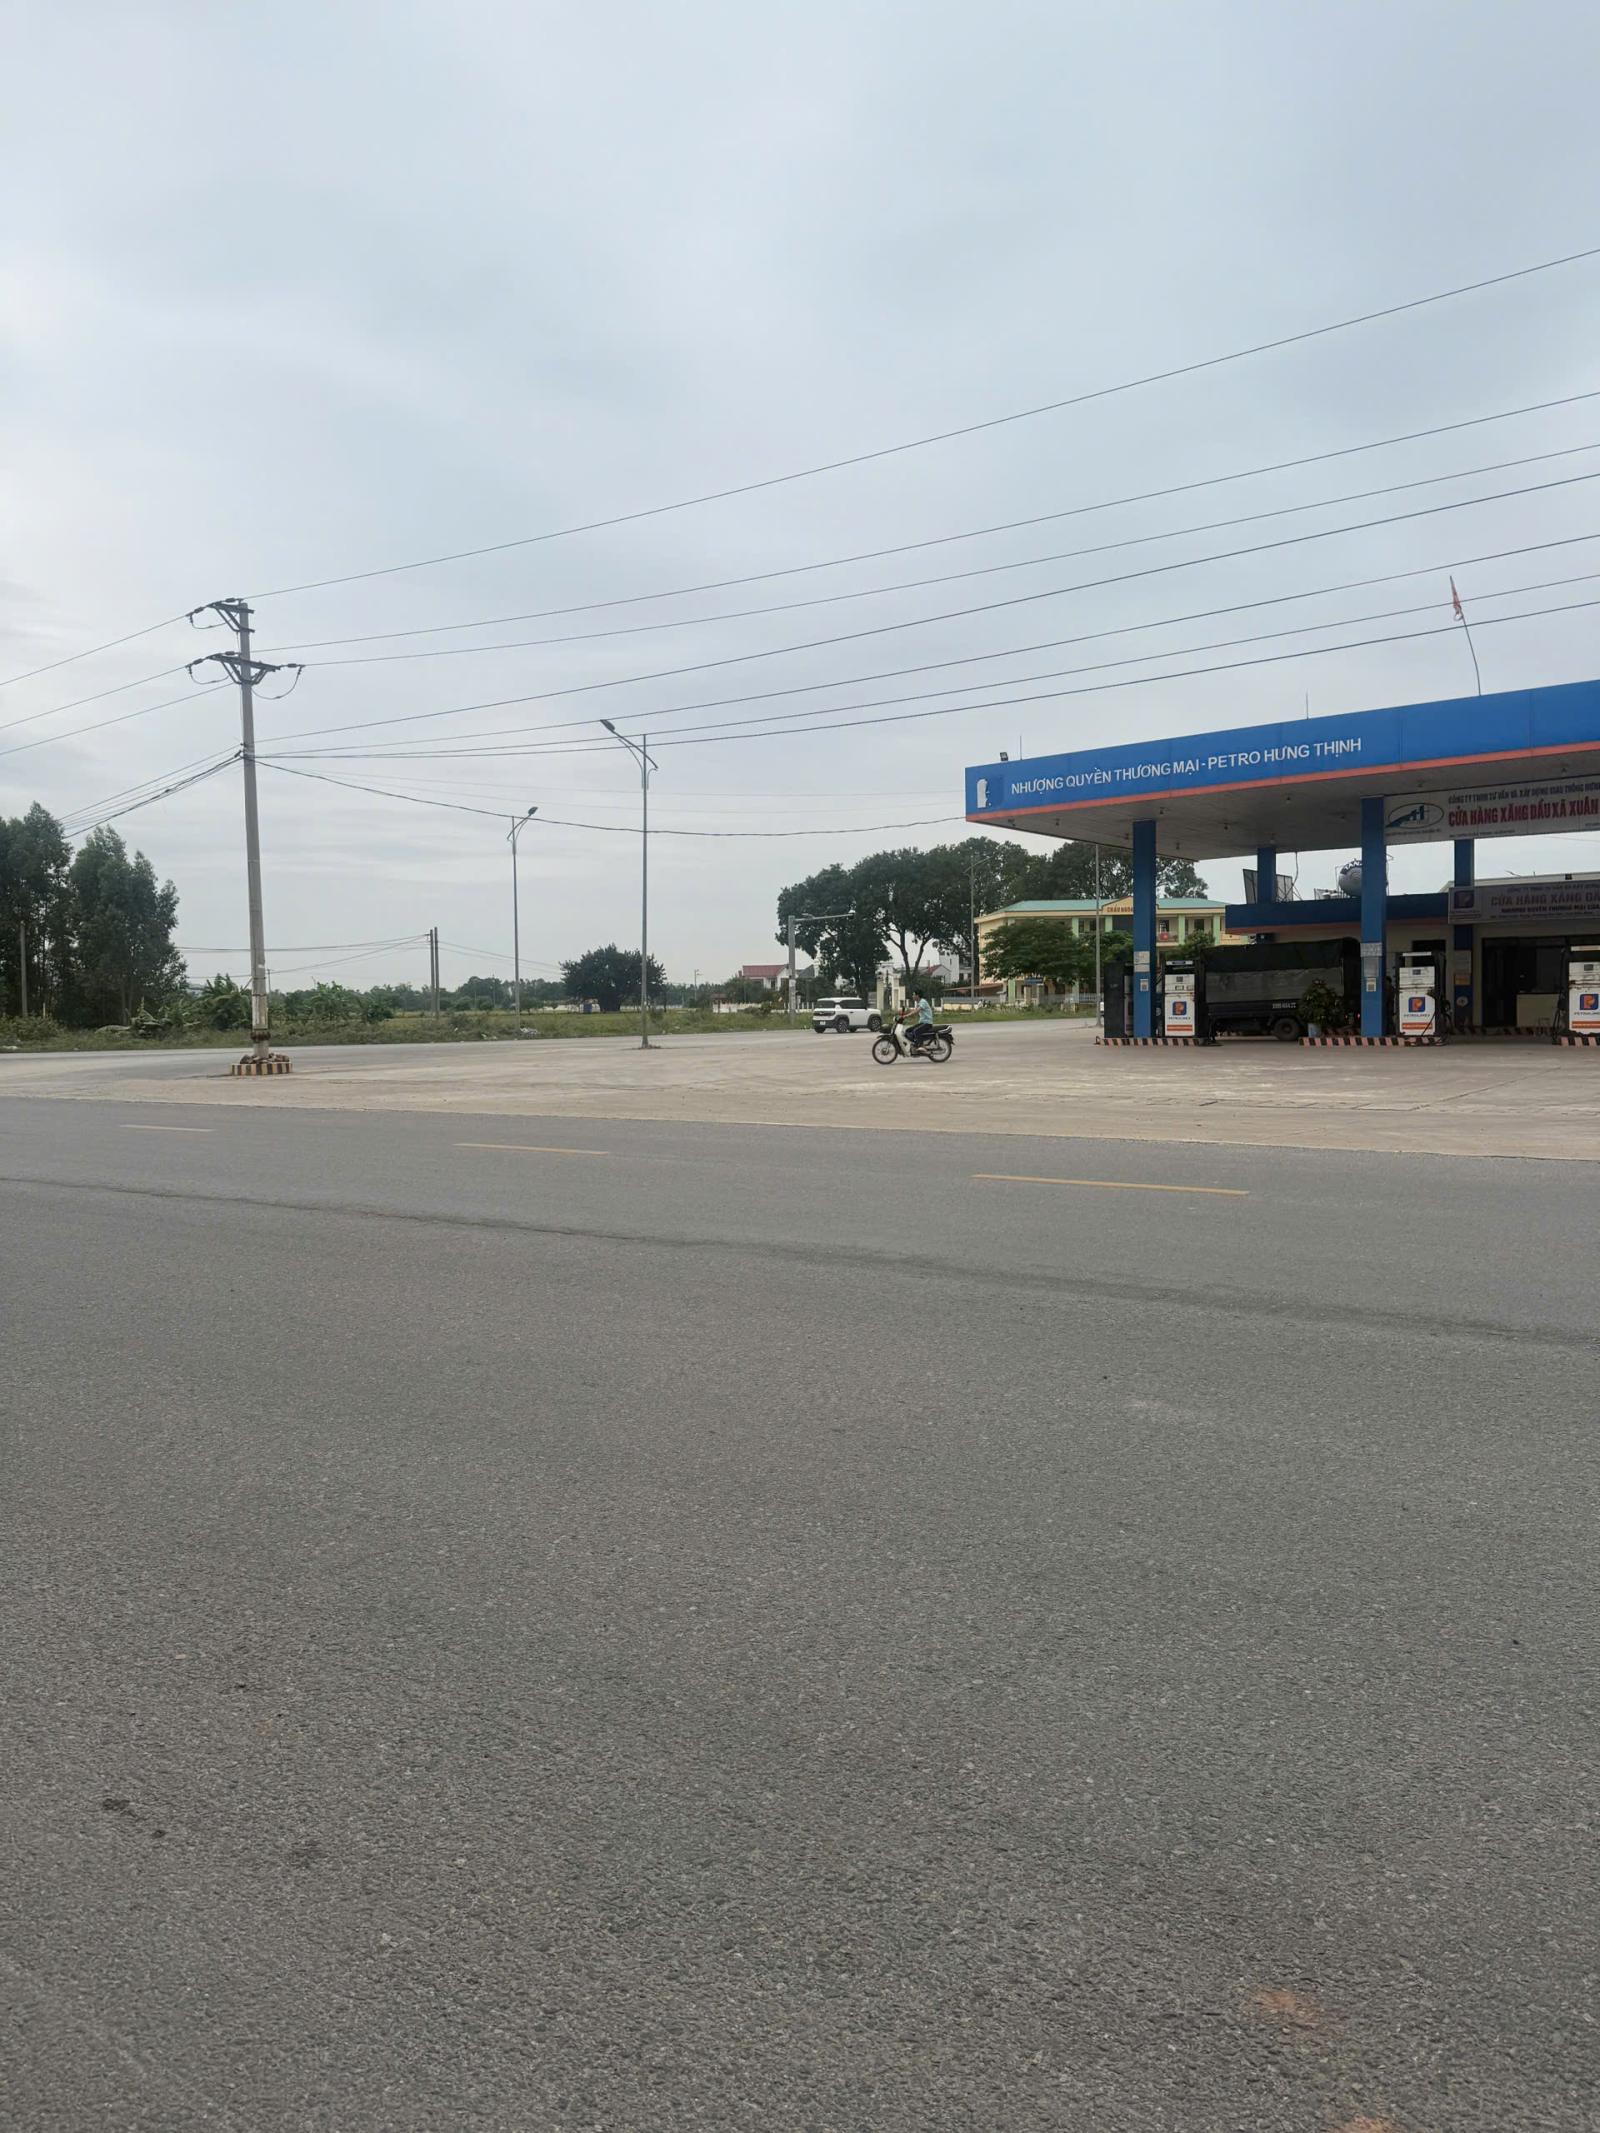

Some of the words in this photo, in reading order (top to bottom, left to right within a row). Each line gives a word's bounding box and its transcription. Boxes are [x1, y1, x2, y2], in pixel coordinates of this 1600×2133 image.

[1011, 777, 1064, 794] NHƯỢNG
[1066, 767, 1111, 787] QUYỀN
[1114, 763, 1170, 782] THƯƠNG
[1264, 745, 1310, 762] HƯNG
[1313, 737, 1361, 757] THỊNH
[1448, 806, 1469, 827] CỬA
[1470, 806, 1498, 826] HÀNG
[1501, 803, 1528, 823] XĂNG
[1552, 799, 1567, 818] XÃ
